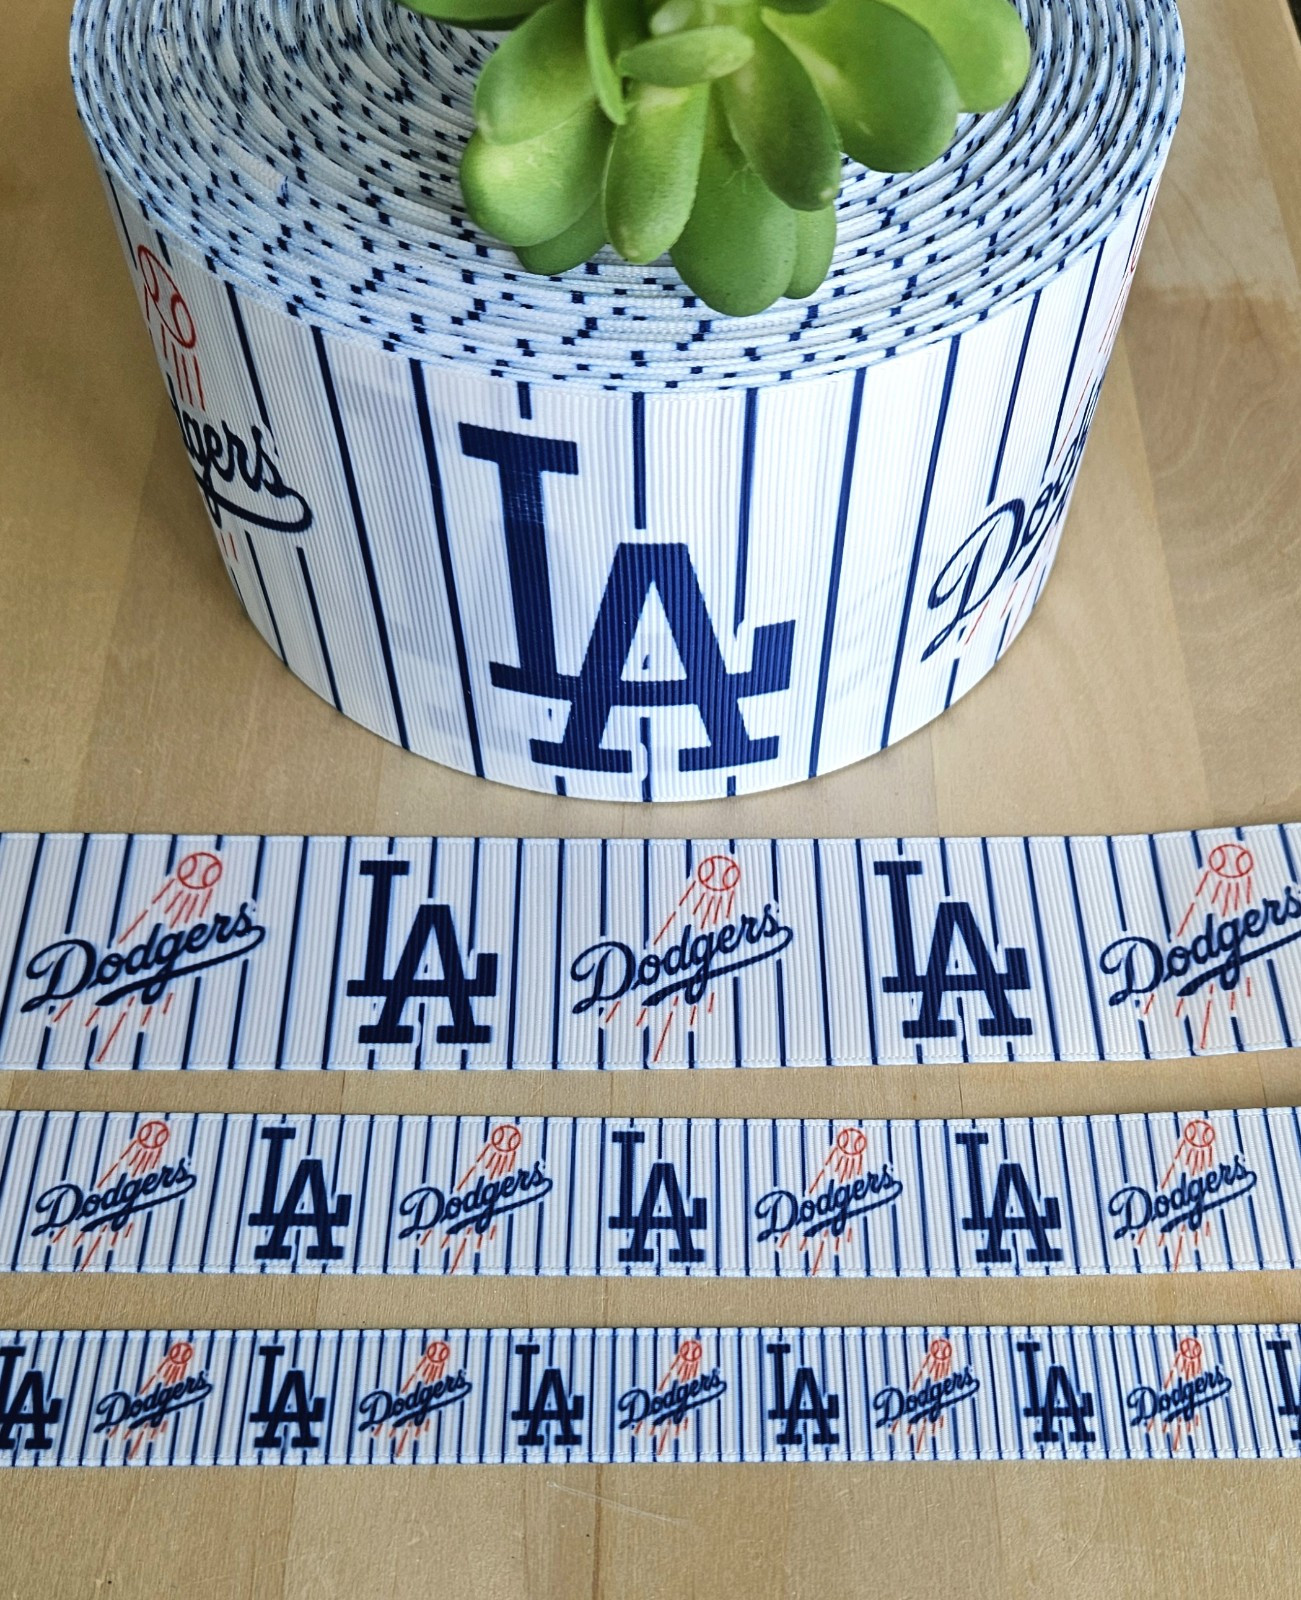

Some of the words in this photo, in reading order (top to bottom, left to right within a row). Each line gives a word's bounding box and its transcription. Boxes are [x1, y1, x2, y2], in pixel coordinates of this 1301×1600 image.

[458, 422, 796, 774] LA
[21, 902, 266, 1012] Dodgers
[347, 860, 499, 1043] LA
[571, 904, 793, 1013] Dodgers
[874, 860, 1032, 1038] LA
[31, 1158, 198, 1236] Dodgers
[248, 1126, 352, 1260] LA
[399, 1161, 553, 1238] Dodgers
[609, 1131, 708, 1263] LA
[755, 1167, 903, 1242] Dodgers
[955, 1133, 1064, 1262] LA
[1109, 1159, 1257, 1240] Dodgers
[0, 1346, 63, 1450] LA
[94, 1369, 213, 1433] Dodgers
[250, 1345, 326, 1448] LA
[358, 1368, 473, 1432] Dodgers
[512, 1344, 584, 1446] LA
[618, 1367, 726, 1430] Dodgers
[767, 1344, 839, 1445] LA
[873, 1365, 979, 1427] Dodgers
[1016, 1341, 1096, 1444] LA
[1127, 1363, 1232, 1427] Dodgers
